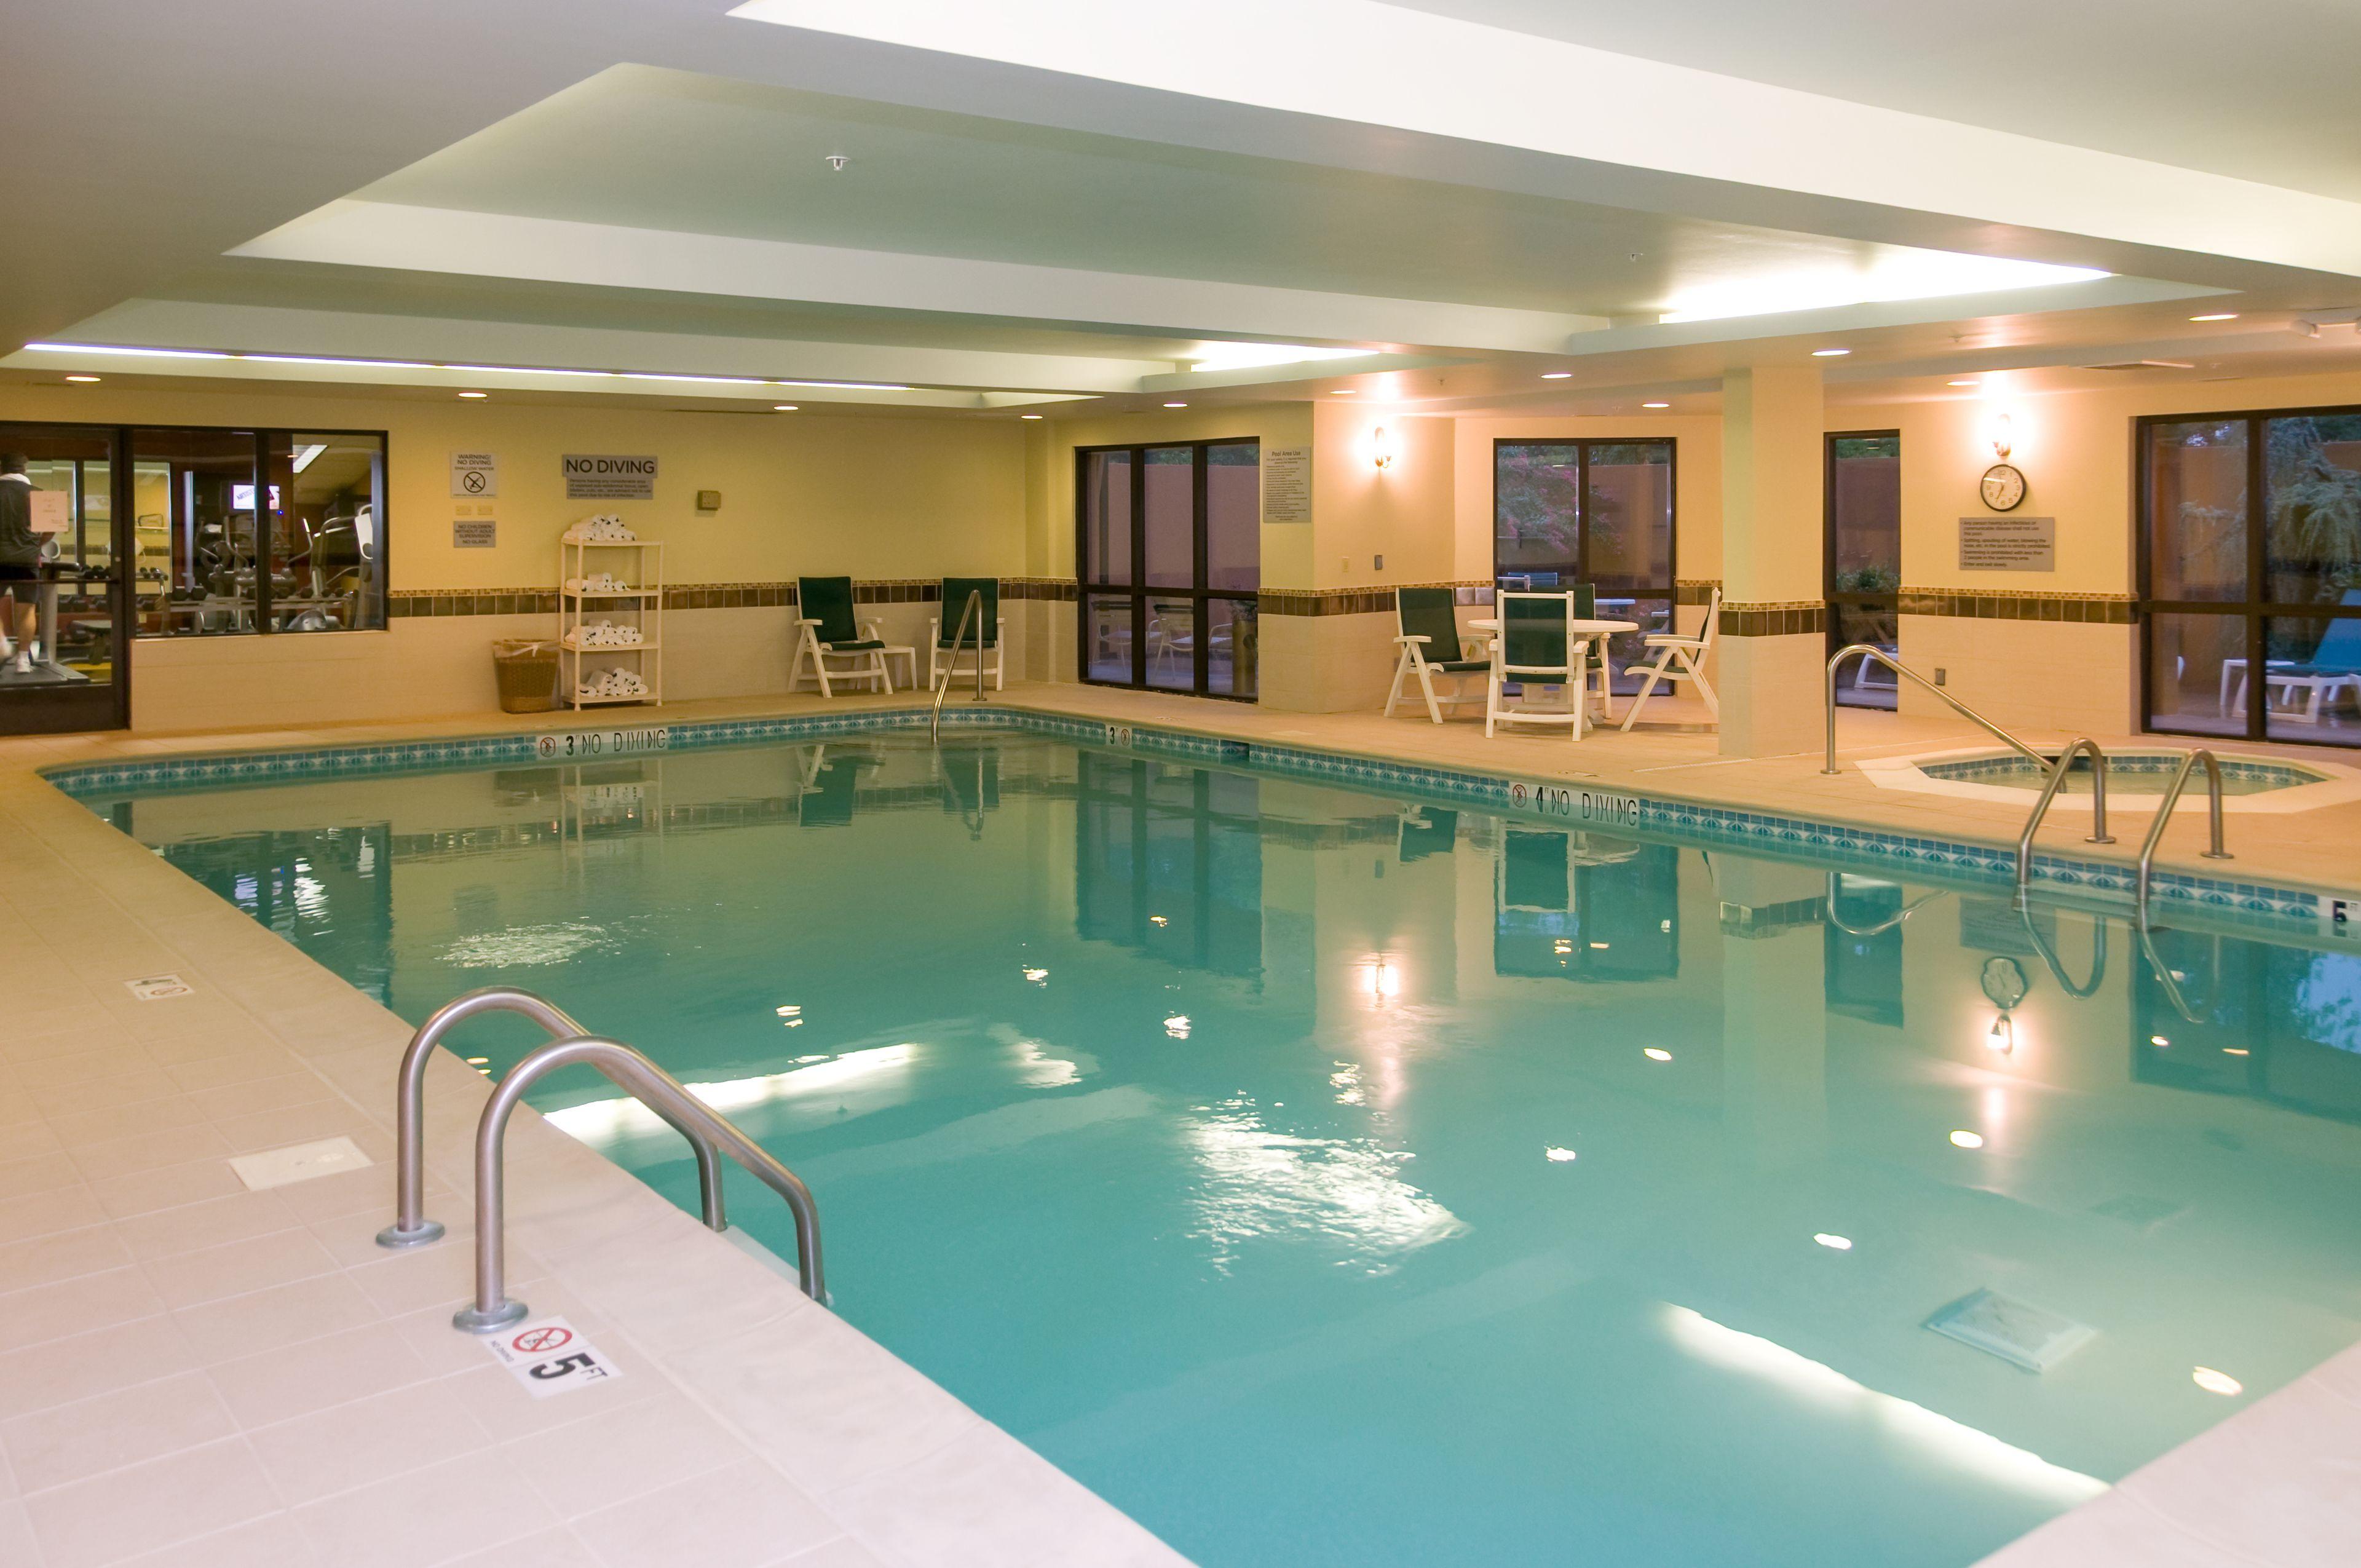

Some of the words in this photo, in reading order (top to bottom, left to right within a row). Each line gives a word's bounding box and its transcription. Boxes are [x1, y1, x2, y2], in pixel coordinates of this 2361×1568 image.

[566, 459, 593, 473] NO
[597, 459, 654, 474] DIVING
[582, 734, 601, 753] NO
[1551, 789, 1570, 813] NO
[2333, 900, 2347, 923] 5
[529, 1352, 596, 1380] 5
[580, 1366, 608, 1380] FT
